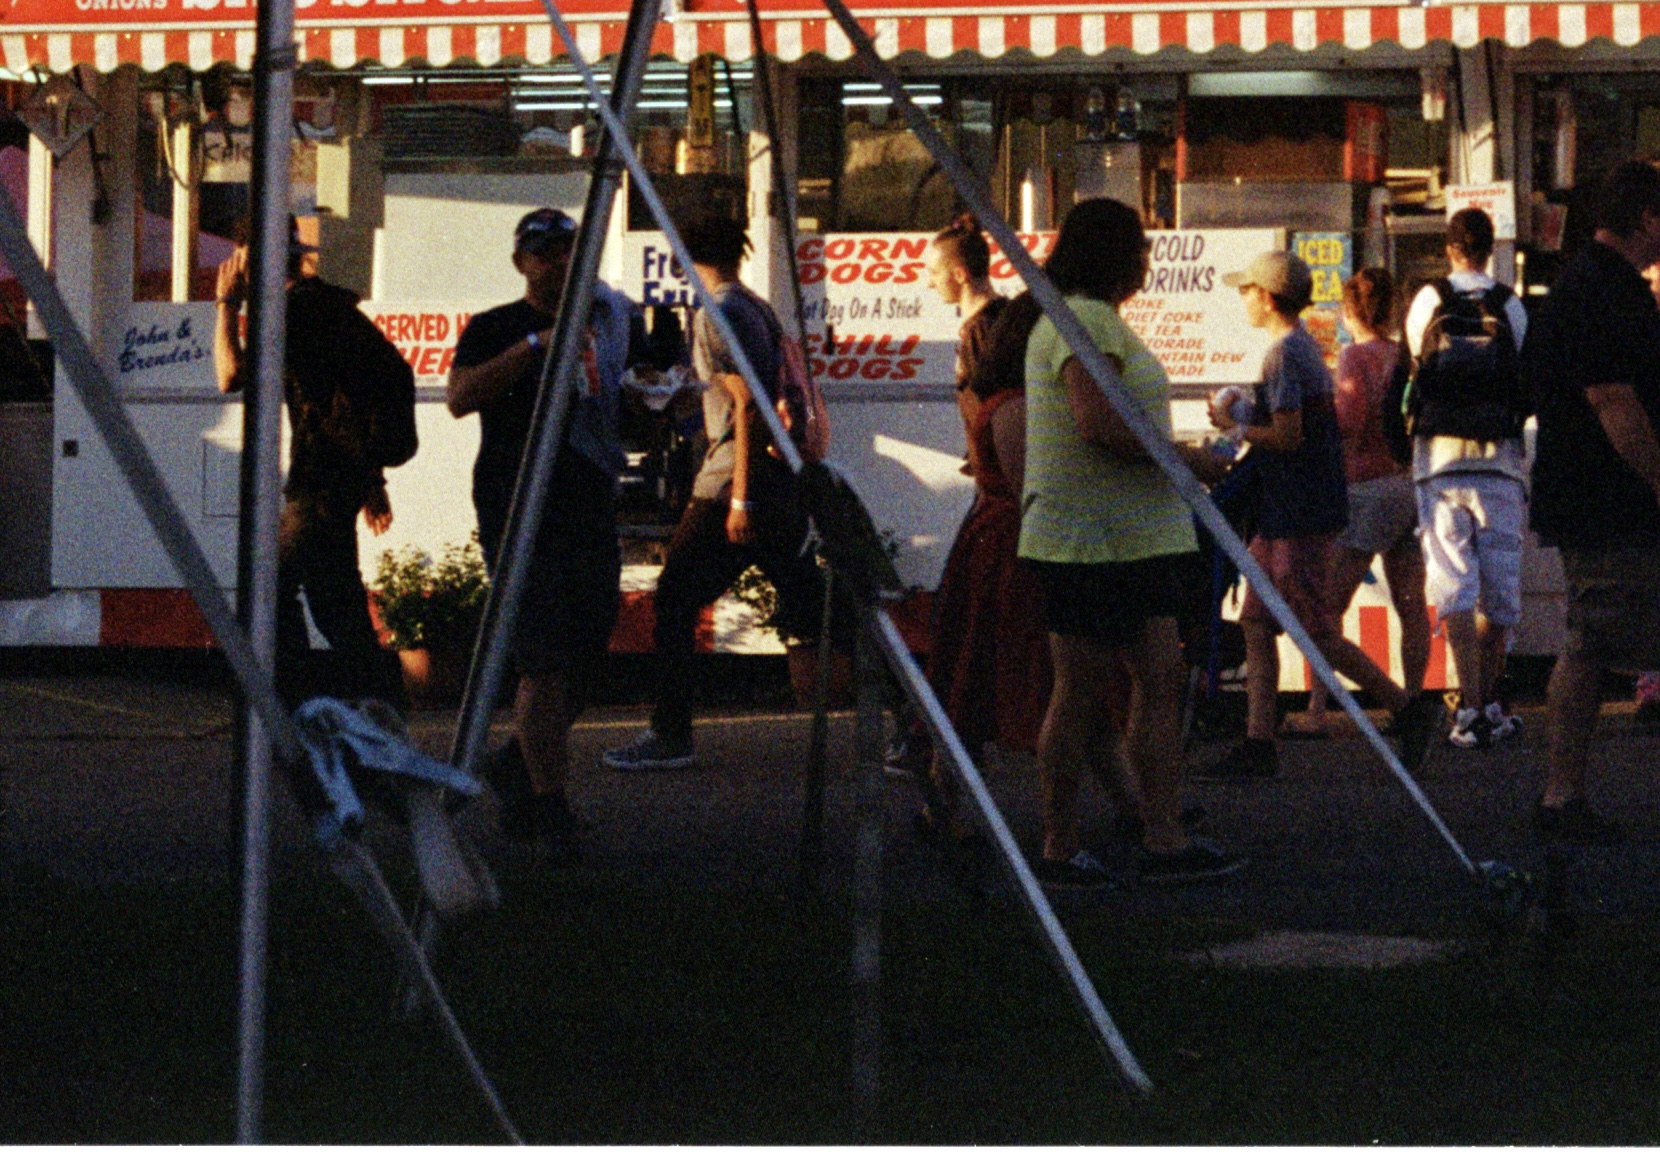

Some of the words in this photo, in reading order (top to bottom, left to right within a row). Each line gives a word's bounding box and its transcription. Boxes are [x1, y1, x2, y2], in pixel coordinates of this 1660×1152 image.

[797, 238, 929, 262] CORN
[1154, 235, 1206, 262] COLD
[798, 262, 927, 285] DOGS
[1311, 269, 1344, 302] EA
[850, 297, 867, 320] On
[871, 297, 883, 319] A
[887, 297, 923, 319] Stick
[1162, 311, 1204, 323] COKE
[1156, 325, 1182, 336] TEA
[1210, 351, 1246, 365] DEW
